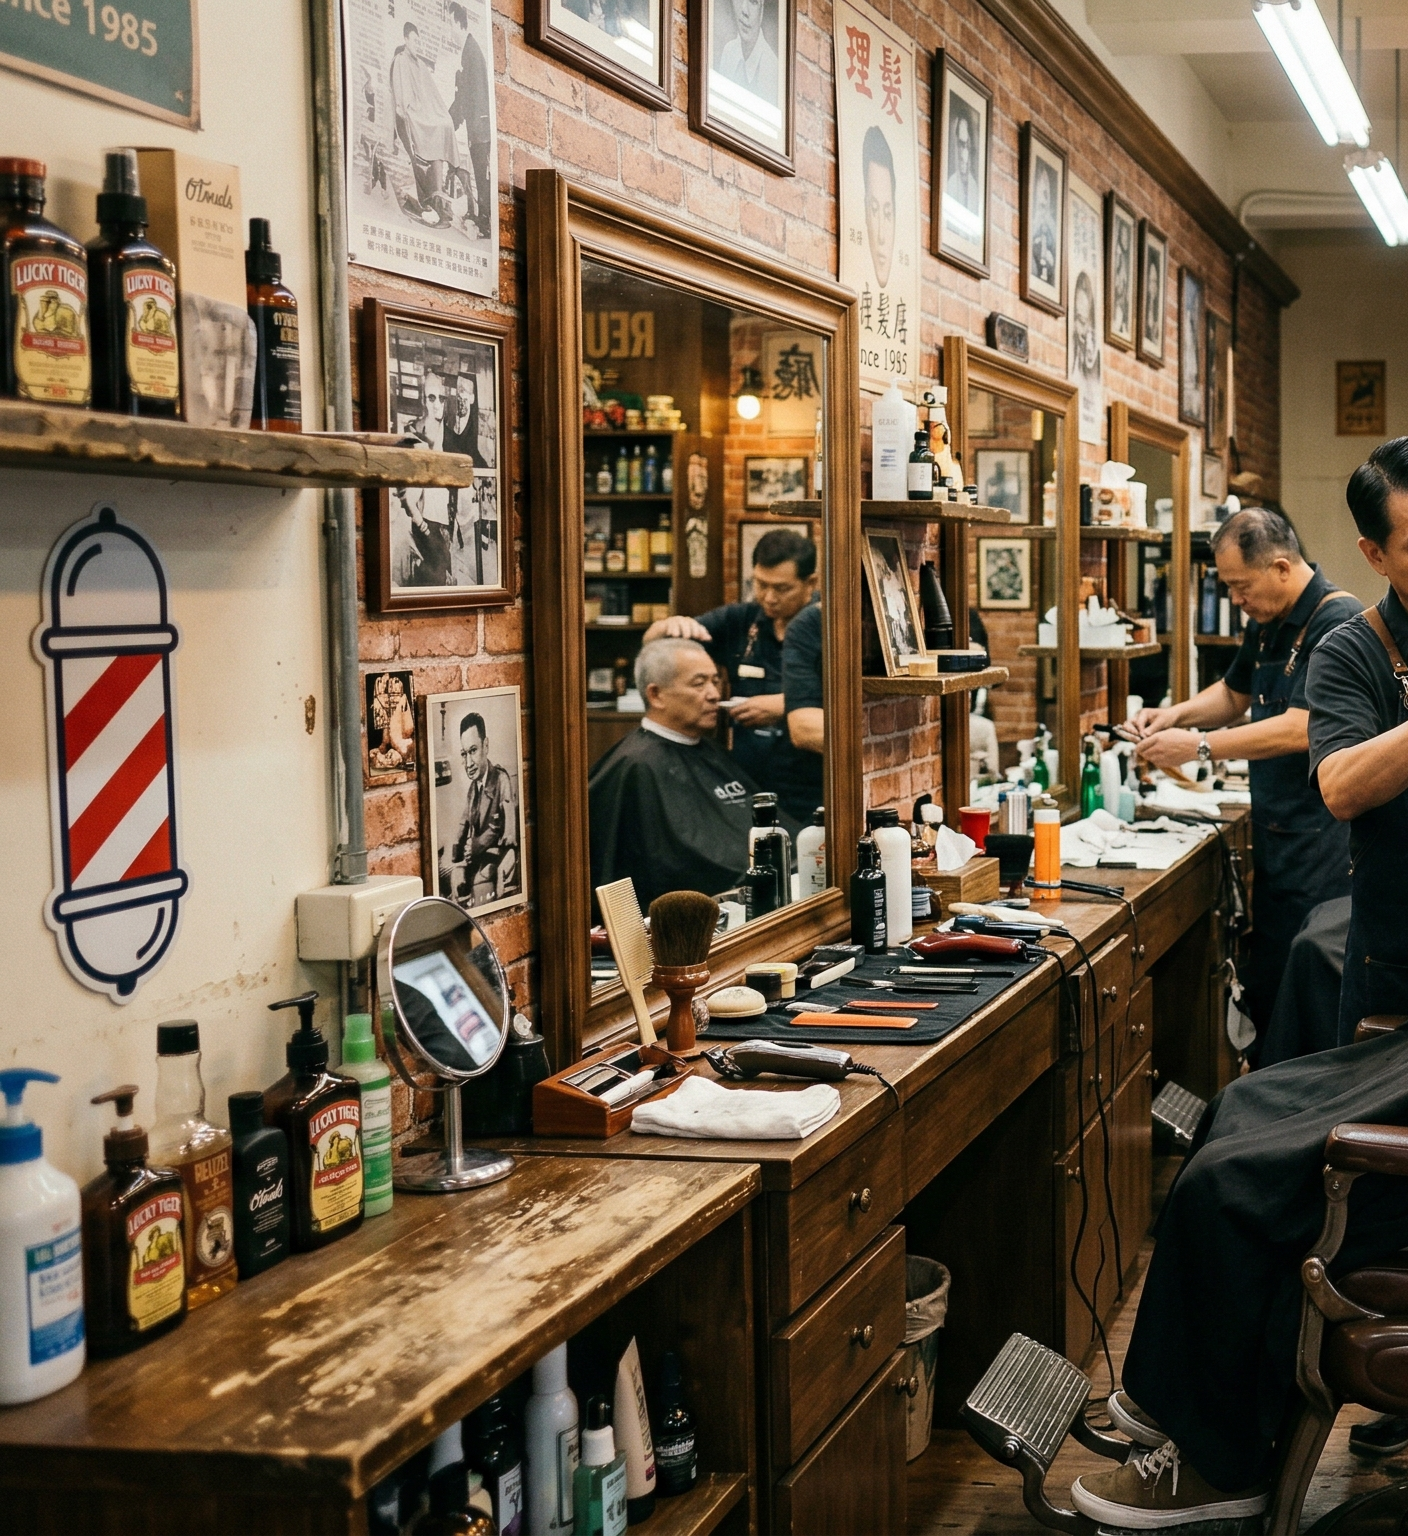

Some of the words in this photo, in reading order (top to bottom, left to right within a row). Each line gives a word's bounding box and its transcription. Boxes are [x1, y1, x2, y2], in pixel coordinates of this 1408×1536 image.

[83, 0, 158, 57] 1985
[16, 263, 55, 287] LUCKY
[126, 275, 153, 294] LUCKY
